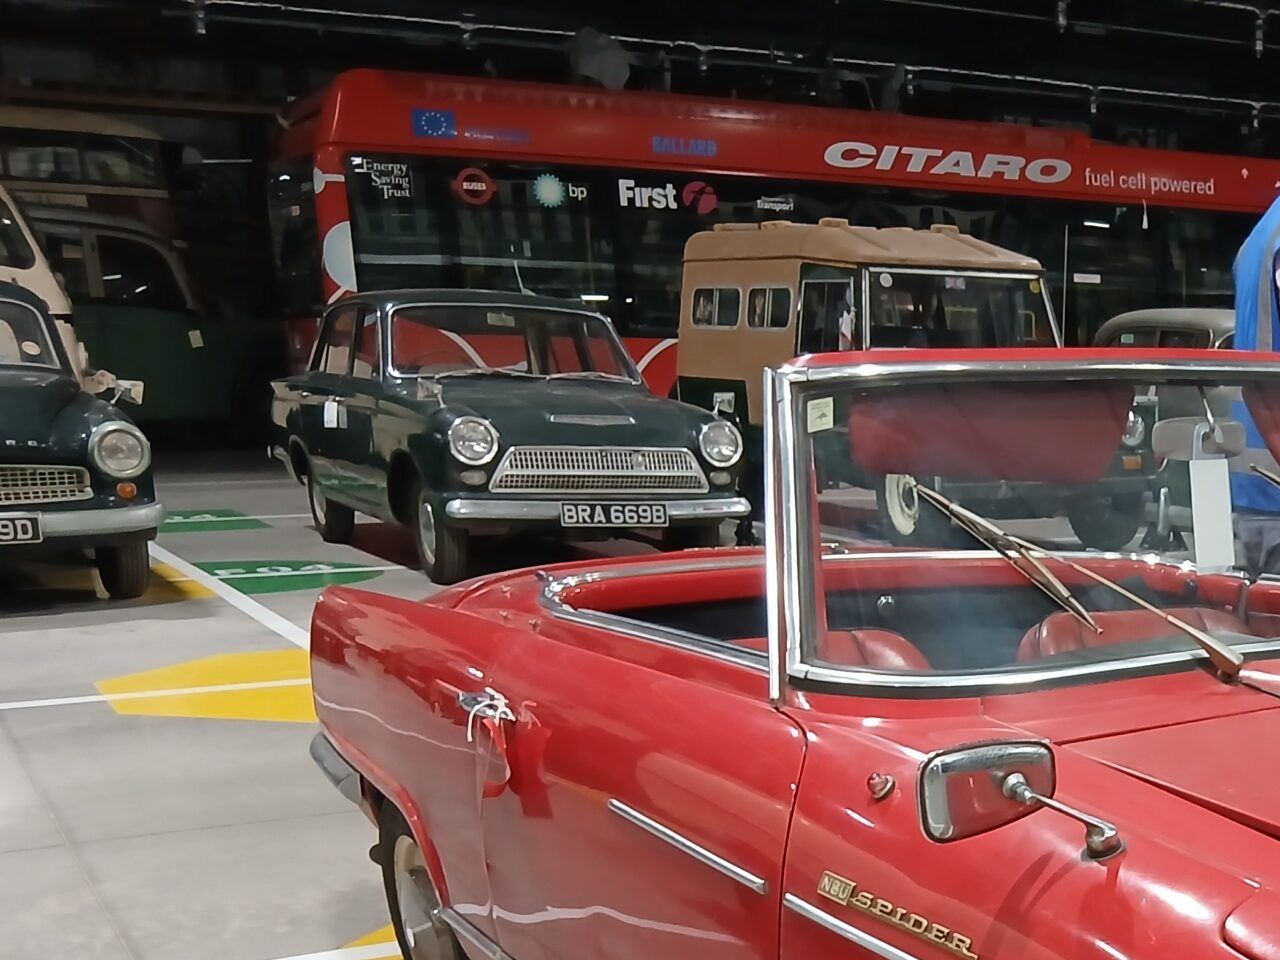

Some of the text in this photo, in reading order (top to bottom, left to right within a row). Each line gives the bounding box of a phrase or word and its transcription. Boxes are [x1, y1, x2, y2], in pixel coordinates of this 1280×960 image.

[652, 136, 718, 157] BALLARD
[363, 158, 408, 177] Energy
[824, 141, 1072, 184] CITARO
[371, 172, 410, 189] Saving
[1084, 167, 1215, 195] fuel cell powered
[379, 185, 410, 200] Trust
[568, 183, 587, 200] bp
[618, 178, 678, 210] First
[563, 504, 665, 524] BRA 669B
